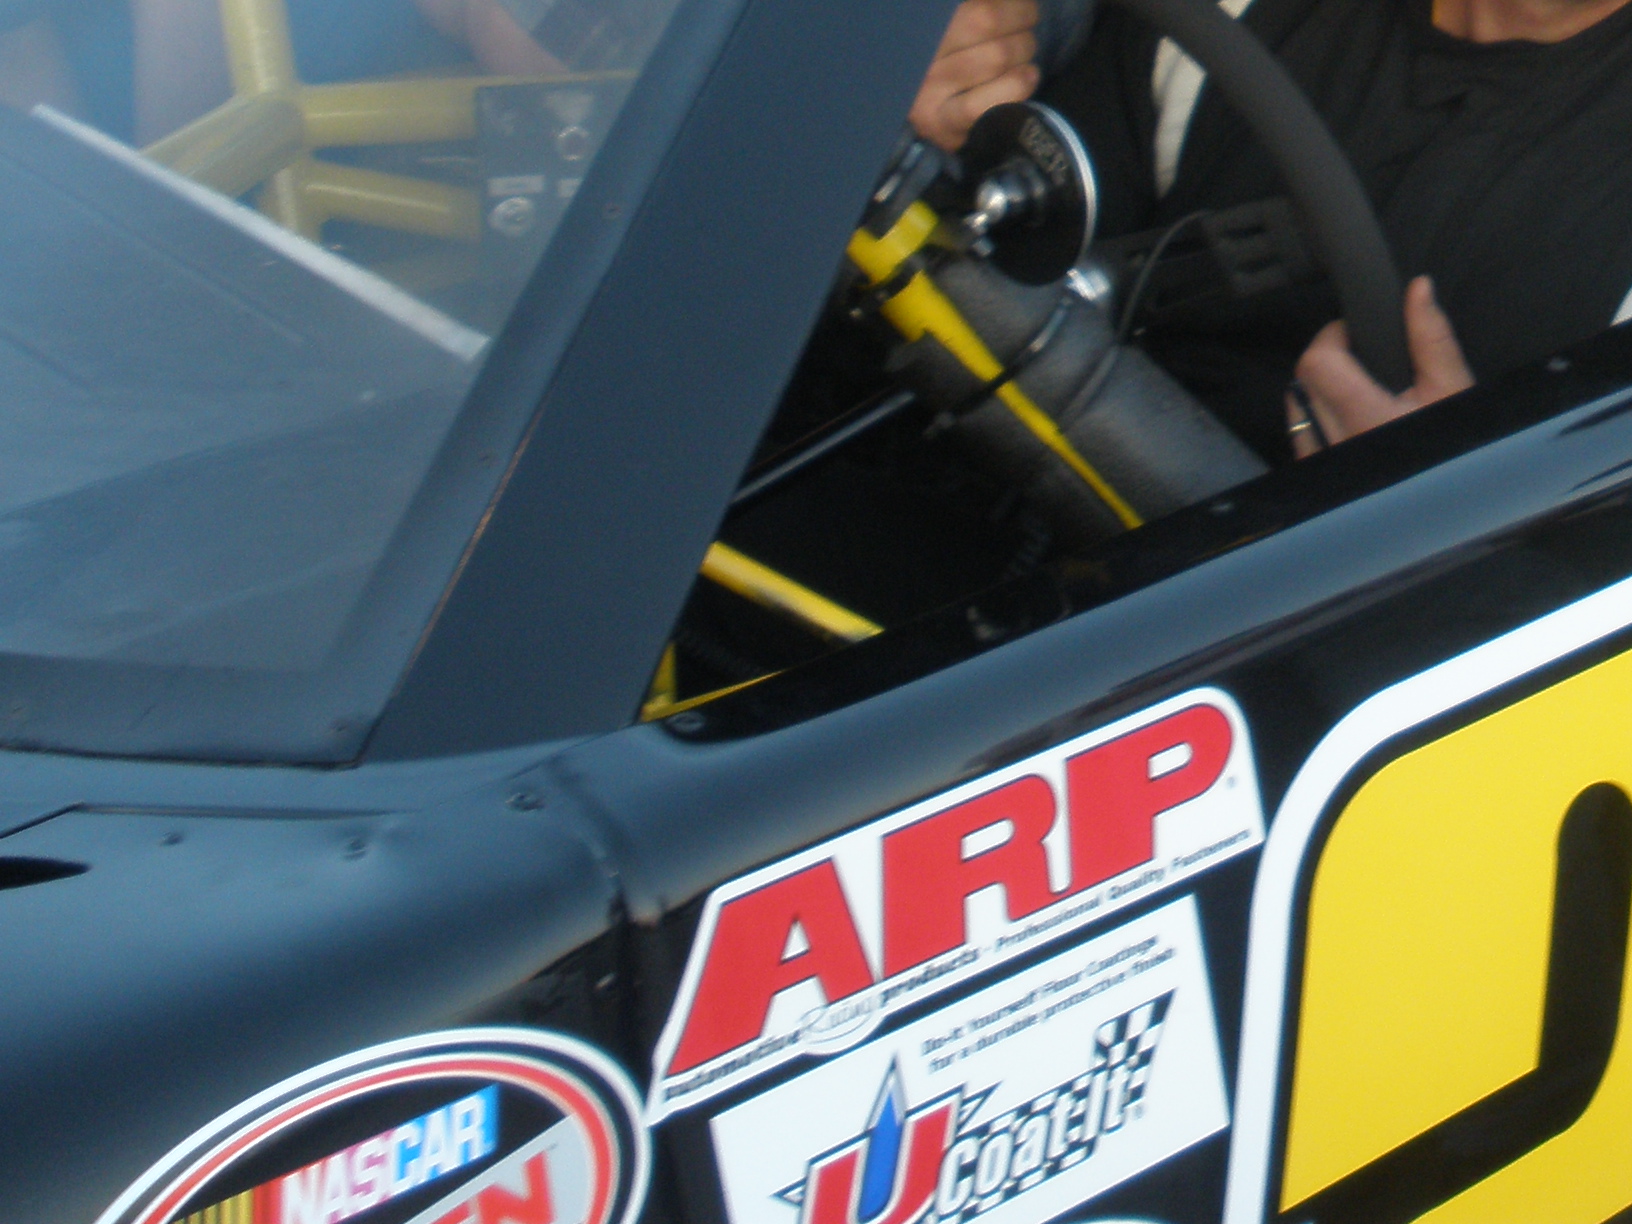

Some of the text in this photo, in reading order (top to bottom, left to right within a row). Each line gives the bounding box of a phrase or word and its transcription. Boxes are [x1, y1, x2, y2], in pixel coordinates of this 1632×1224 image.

[666, 702, 1233, 1078] ARP
[995, 897, 1100, 952] Professional
[1107, 867, 1166, 901] Quality
[1170, 828, 1251, 872] Fasteners
[928, 1052, 957, 1074] for
[974, 1012, 1040, 1052] durable
[1129, 946, 1177, 978] finish
[1085, 935, 1158, 977] Coatings
[280, 1088, 490, 1224] NASCAR
